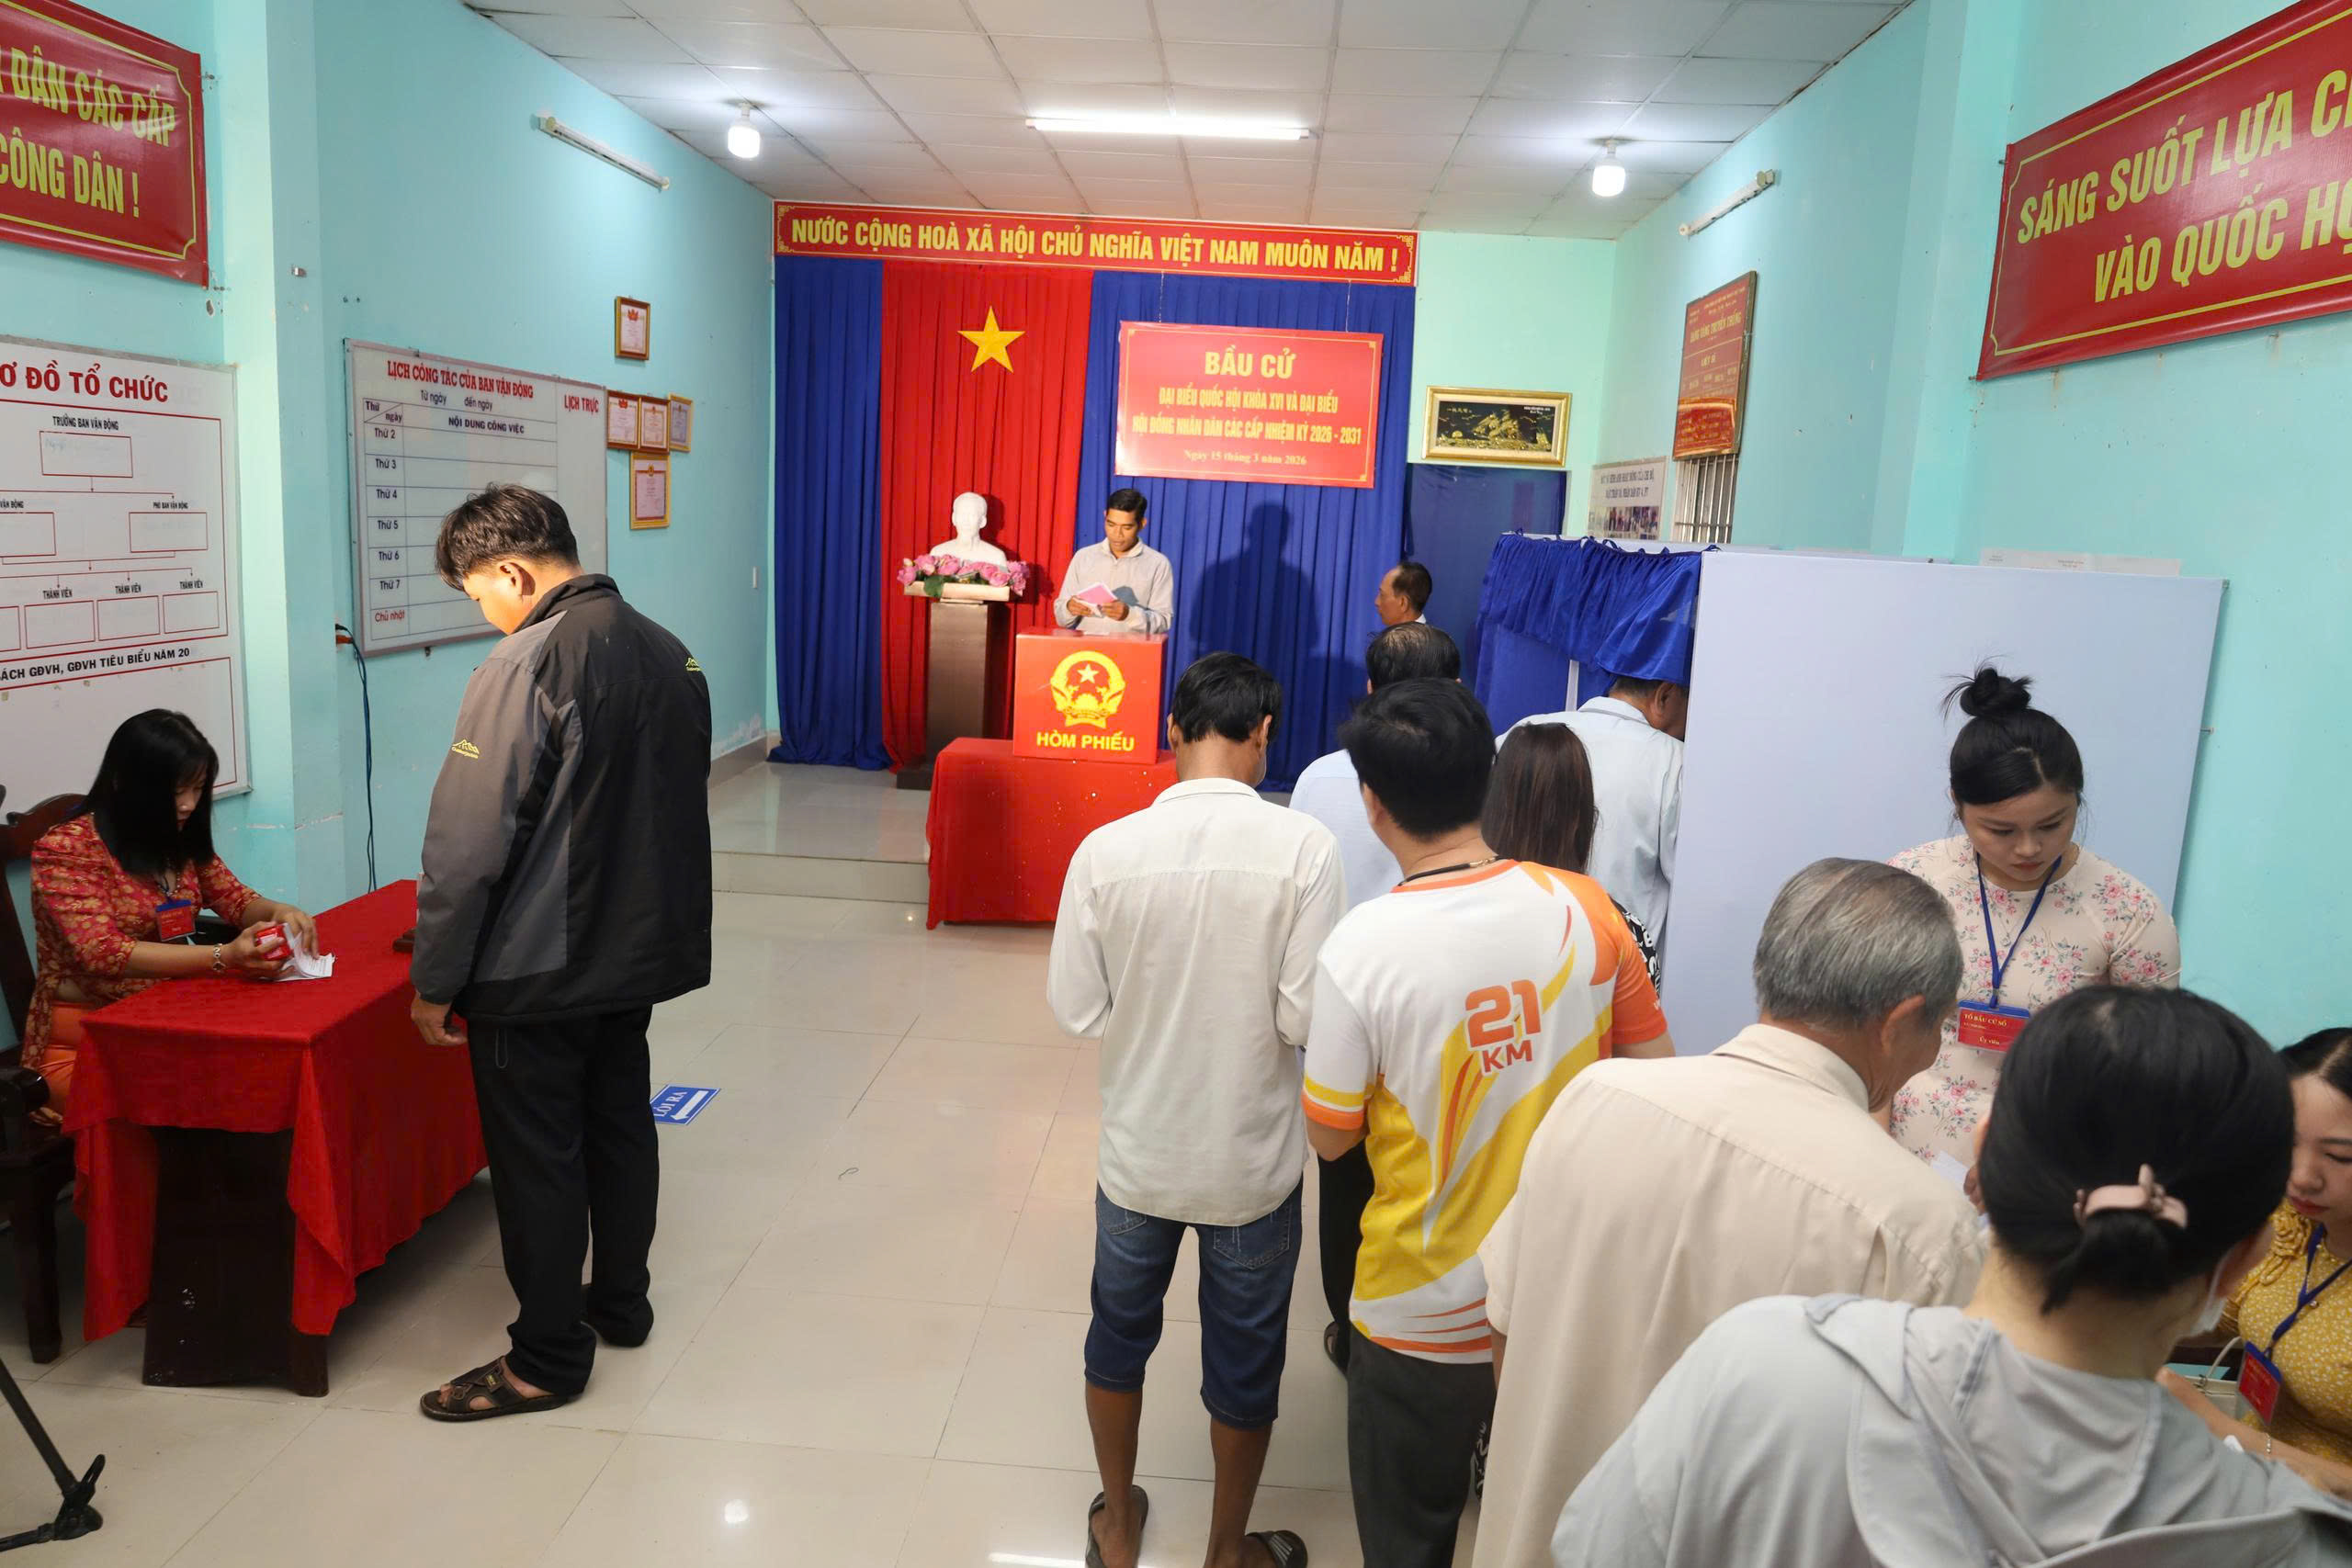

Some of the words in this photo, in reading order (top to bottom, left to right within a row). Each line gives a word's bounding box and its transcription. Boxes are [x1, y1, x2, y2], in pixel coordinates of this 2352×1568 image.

[11, 44, 69, 114] DÂN
[74, 69, 124, 132] CÁC
[131, 84, 176, 147] CẤP
[2017, 171, 2099, 244] SÁNG
[2106, 115, 2204, 212] SUỐT
[2210, 89, 2293, 178] LỰA
[73, 150, 124, 214] DÂN
[131, 172, 140, 218] !
[792, 215, 848, 245] NƯỚC
[855, 218, 911, 252] CỘNG
[918, 221, 960, 251] HOÀ
[966, 223, 994, 252] XÃ
[1000, 224, 1035, 259] HỘI
[1041, 224, 1083, 256] CHỦ
[1089, 231, 1154, 260] NGHĨA
[1159, 232, 1204, 267] VIỆT
[1209, 239, 1259, 265] NAM
[1265, 238, 1329, 268] MUÔN
[1334, 241, 1384, 272] NĂM
[1391, 248, 1397, 272] !
[2094, 233, 2162, 303] VÀO
[2171, 182, 2289, 287] QUỐC
[1204, 344, 1253, 377] BẦU
[1261, 347, 1296, 379] CỬ
[25, 359, 61, 391] ĐỒ
[69, 363, 101, 396] TỔ
[109, 375, 168, 402] CHỨC
[387, 360, 411, 380] LỊCH
[413, 363, 438, 383] CÔNG
[440, 367, 458, 387] TÁC
[458, 369, 477, 389] CỦA
[478, 377, 494, 392] BAN
[495, 378, 511, 397] VẬN
[512, 379, 534, 400] ĐỘNG
[564, 395, 580, 412] LỊCH
[390, 429, 396, 439] 2
[448, 416, 462, 428] NỘI
[465, 418, 485, 430] DUNG
[487, 420, 506, 432] CÔNG
[508, 422, 525, 434] VIỆC
[1309, 425, 1332, 443] 2026
[1340, 425, 1362, 445] 2031
[391, 459, 396, 469] 3
[392, 490, 397, 499] 4
[393, 520, 398, 530] 5
[394, 550, 400, 560] 6
[396, 579, 400, 589] 7
[0, 668, 25, 682] ÁCH
[29, 664, 64, 677] GĐVH,
[67, 660, 96, 672] GĐVH
[99, 654, 124, 668] TIÊU
[127, 649, 151, 664] BIỂU
[153, 649, 175, 660] NĂM
[177, 647, 189, 658] 20
[1036, 729, 1077, 748] HÒM
[1081, 730, 1135, 751] PHIẾU
[1464, 978, 1541, 1048] 21
[1482, 1039, 1532, 1073] KM
